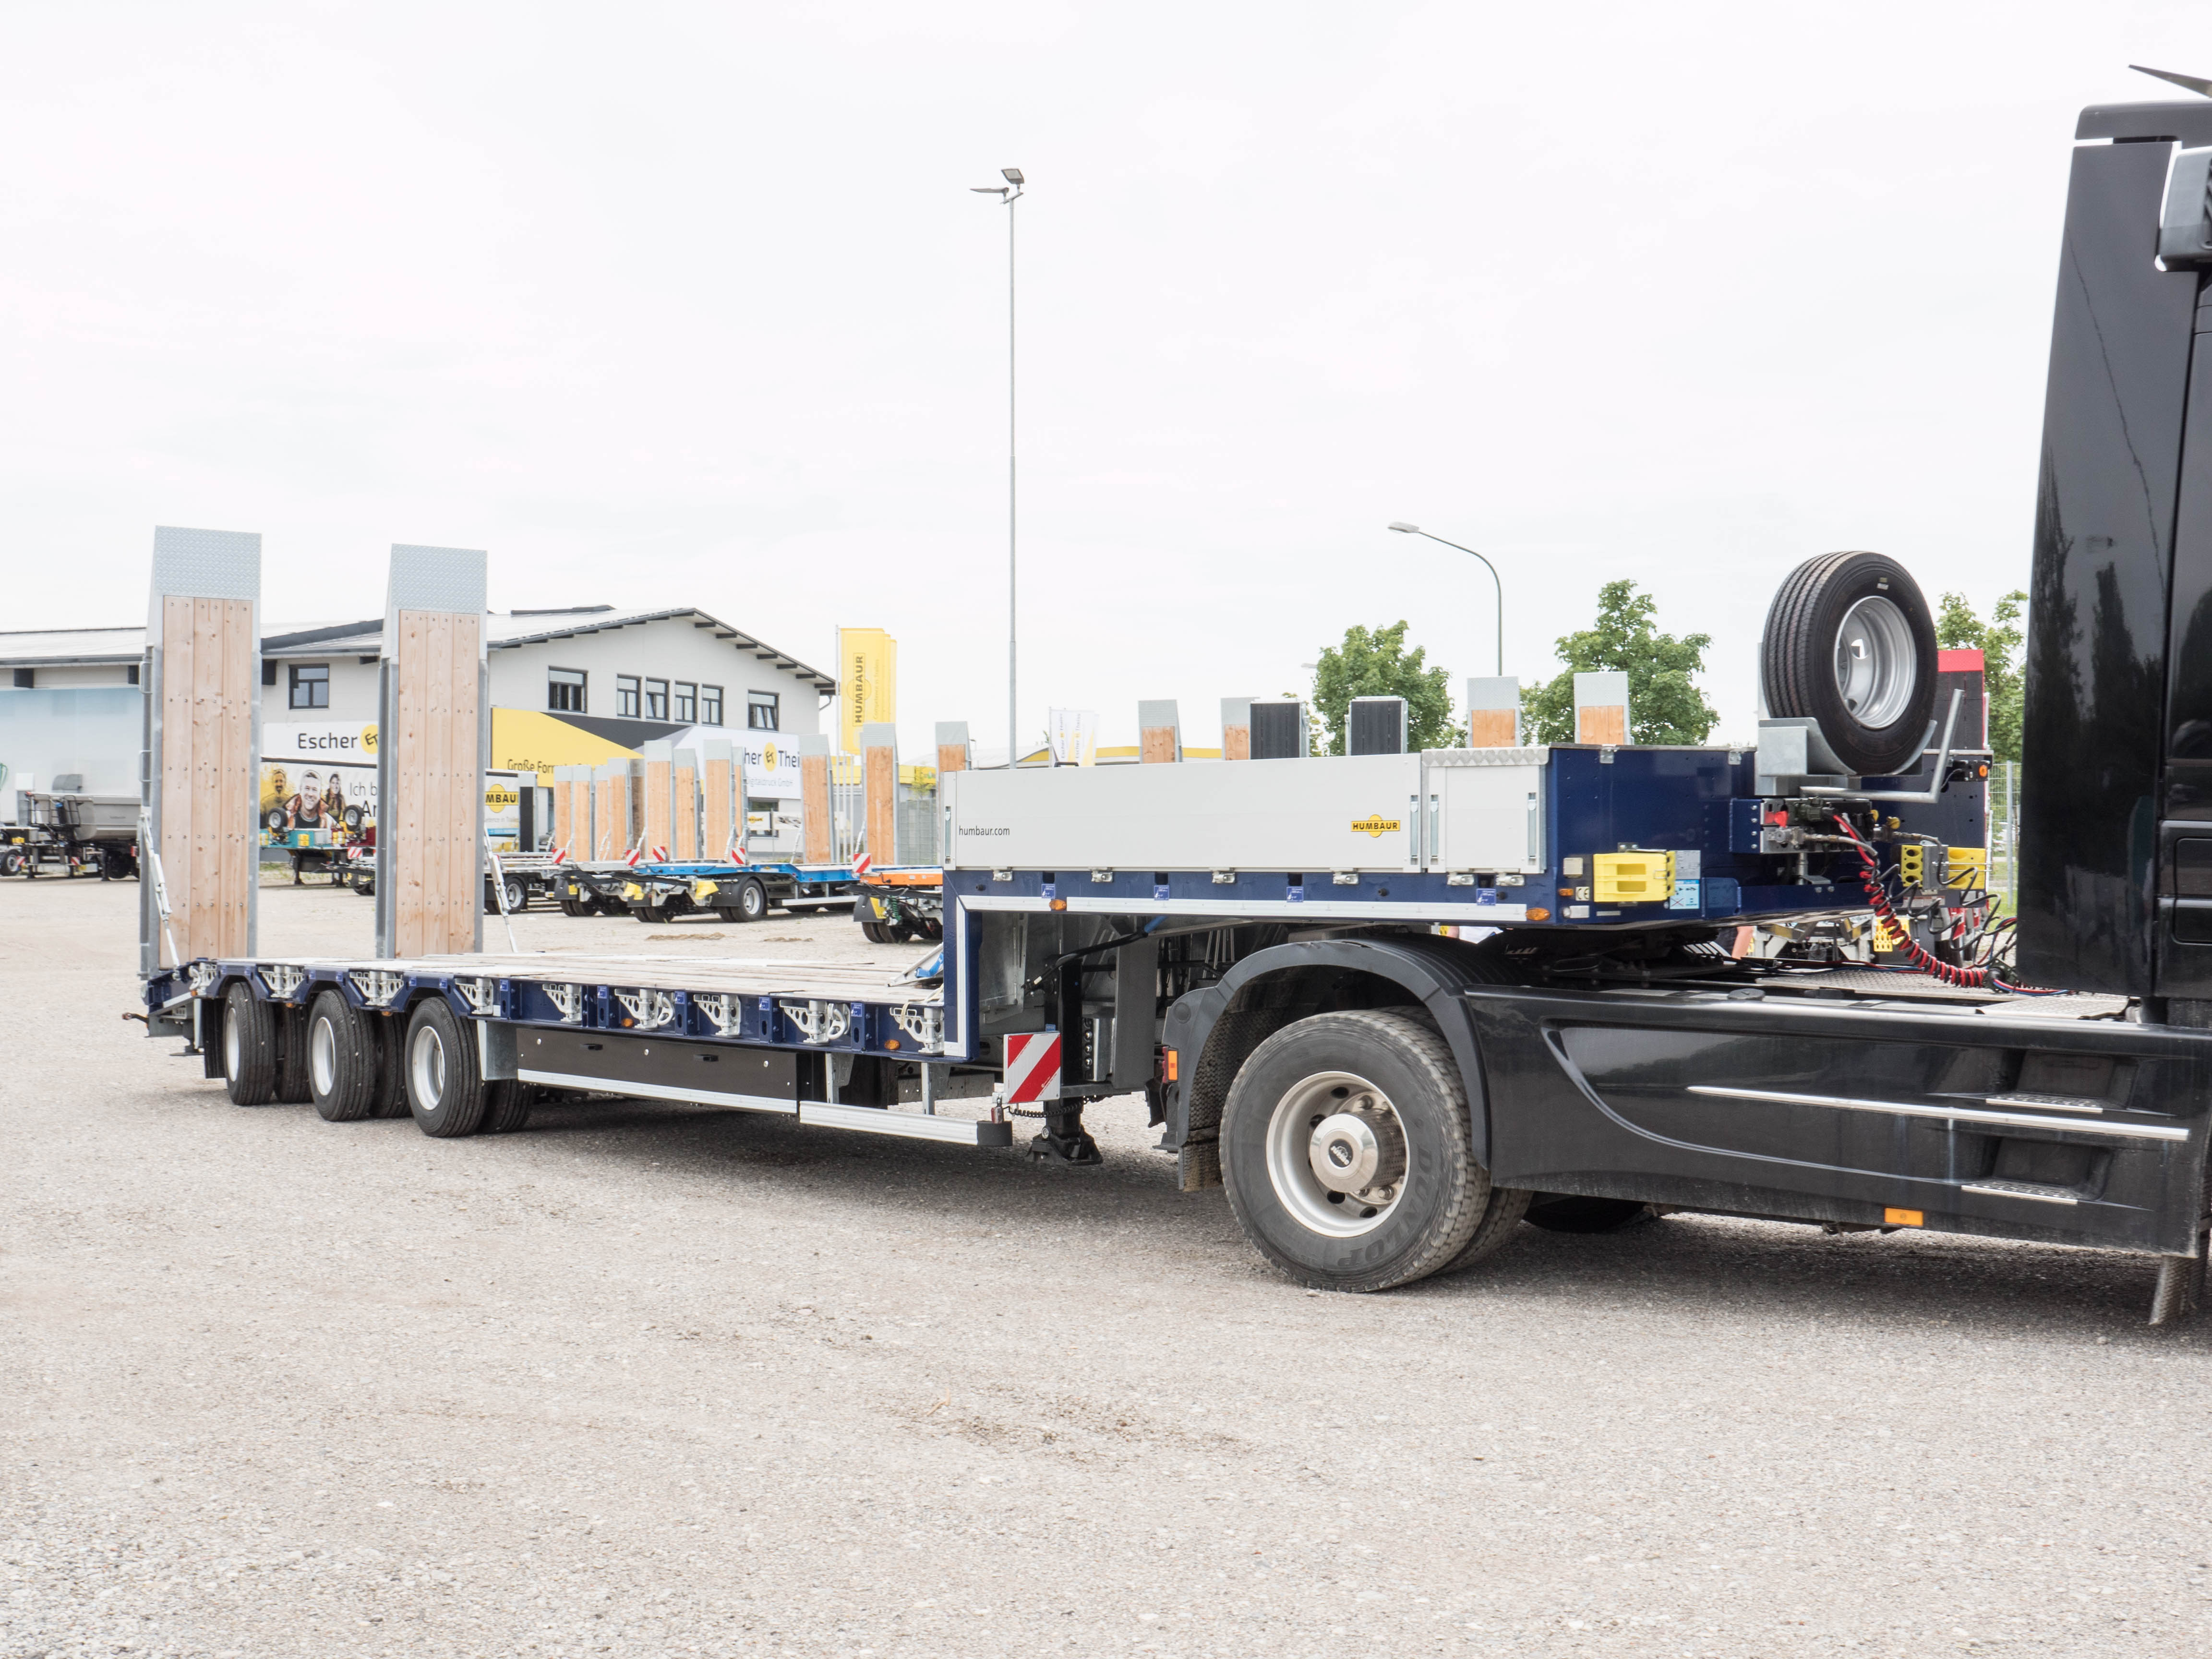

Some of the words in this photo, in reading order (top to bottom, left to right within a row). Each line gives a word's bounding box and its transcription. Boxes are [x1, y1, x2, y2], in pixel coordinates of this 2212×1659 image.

[298, 733, 358, 749] Escher
[507, 759, 535, 772] Große
[349, 782, 366, 796] Ich
[486, 794, 518, 803] MBAU
[959, 826, 1010, 835] humbaur.com
[1337, 1145, 1433, 1267] DUNLOP
